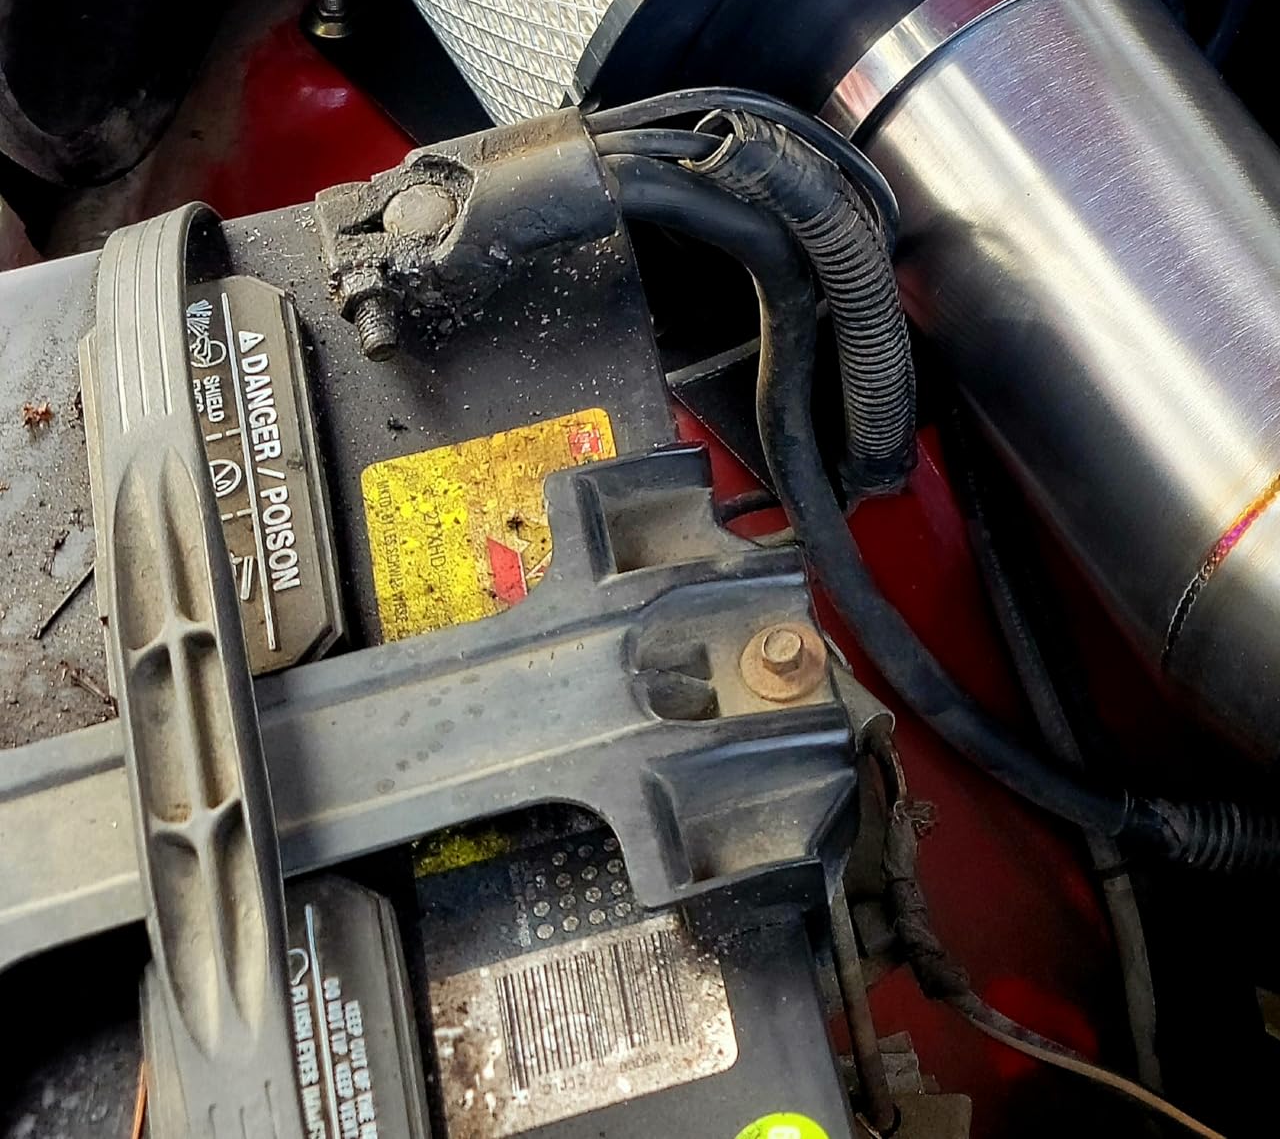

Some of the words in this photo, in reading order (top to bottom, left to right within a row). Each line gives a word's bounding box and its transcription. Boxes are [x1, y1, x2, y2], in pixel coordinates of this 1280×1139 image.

[203, 374, 225, 424] SHIELD
[241, 352, 282, 463] DANGER
[259, 484, 301, 592] POISON
